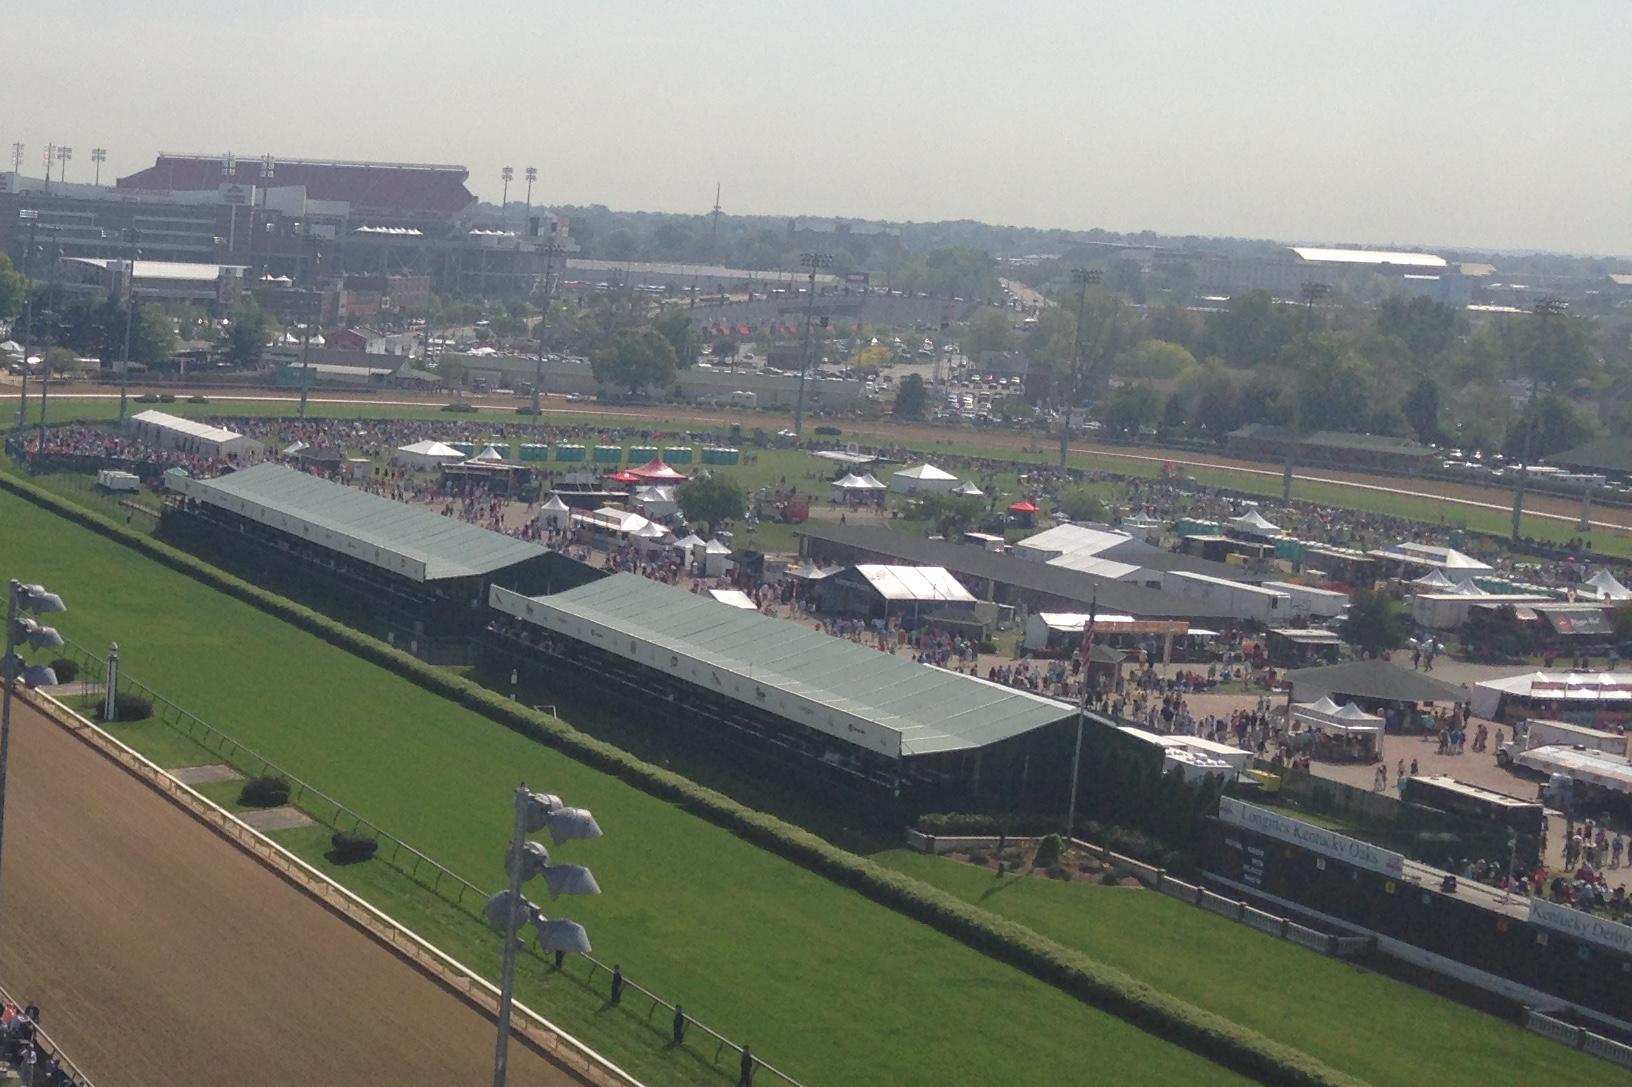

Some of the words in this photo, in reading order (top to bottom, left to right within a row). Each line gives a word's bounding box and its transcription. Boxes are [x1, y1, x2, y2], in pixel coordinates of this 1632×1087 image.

[1293, 824, 1347, 854] Kentucky
[1349, 844, 1379, 865] Oaks
[1534, 904, 1589, 935] Kentucky
